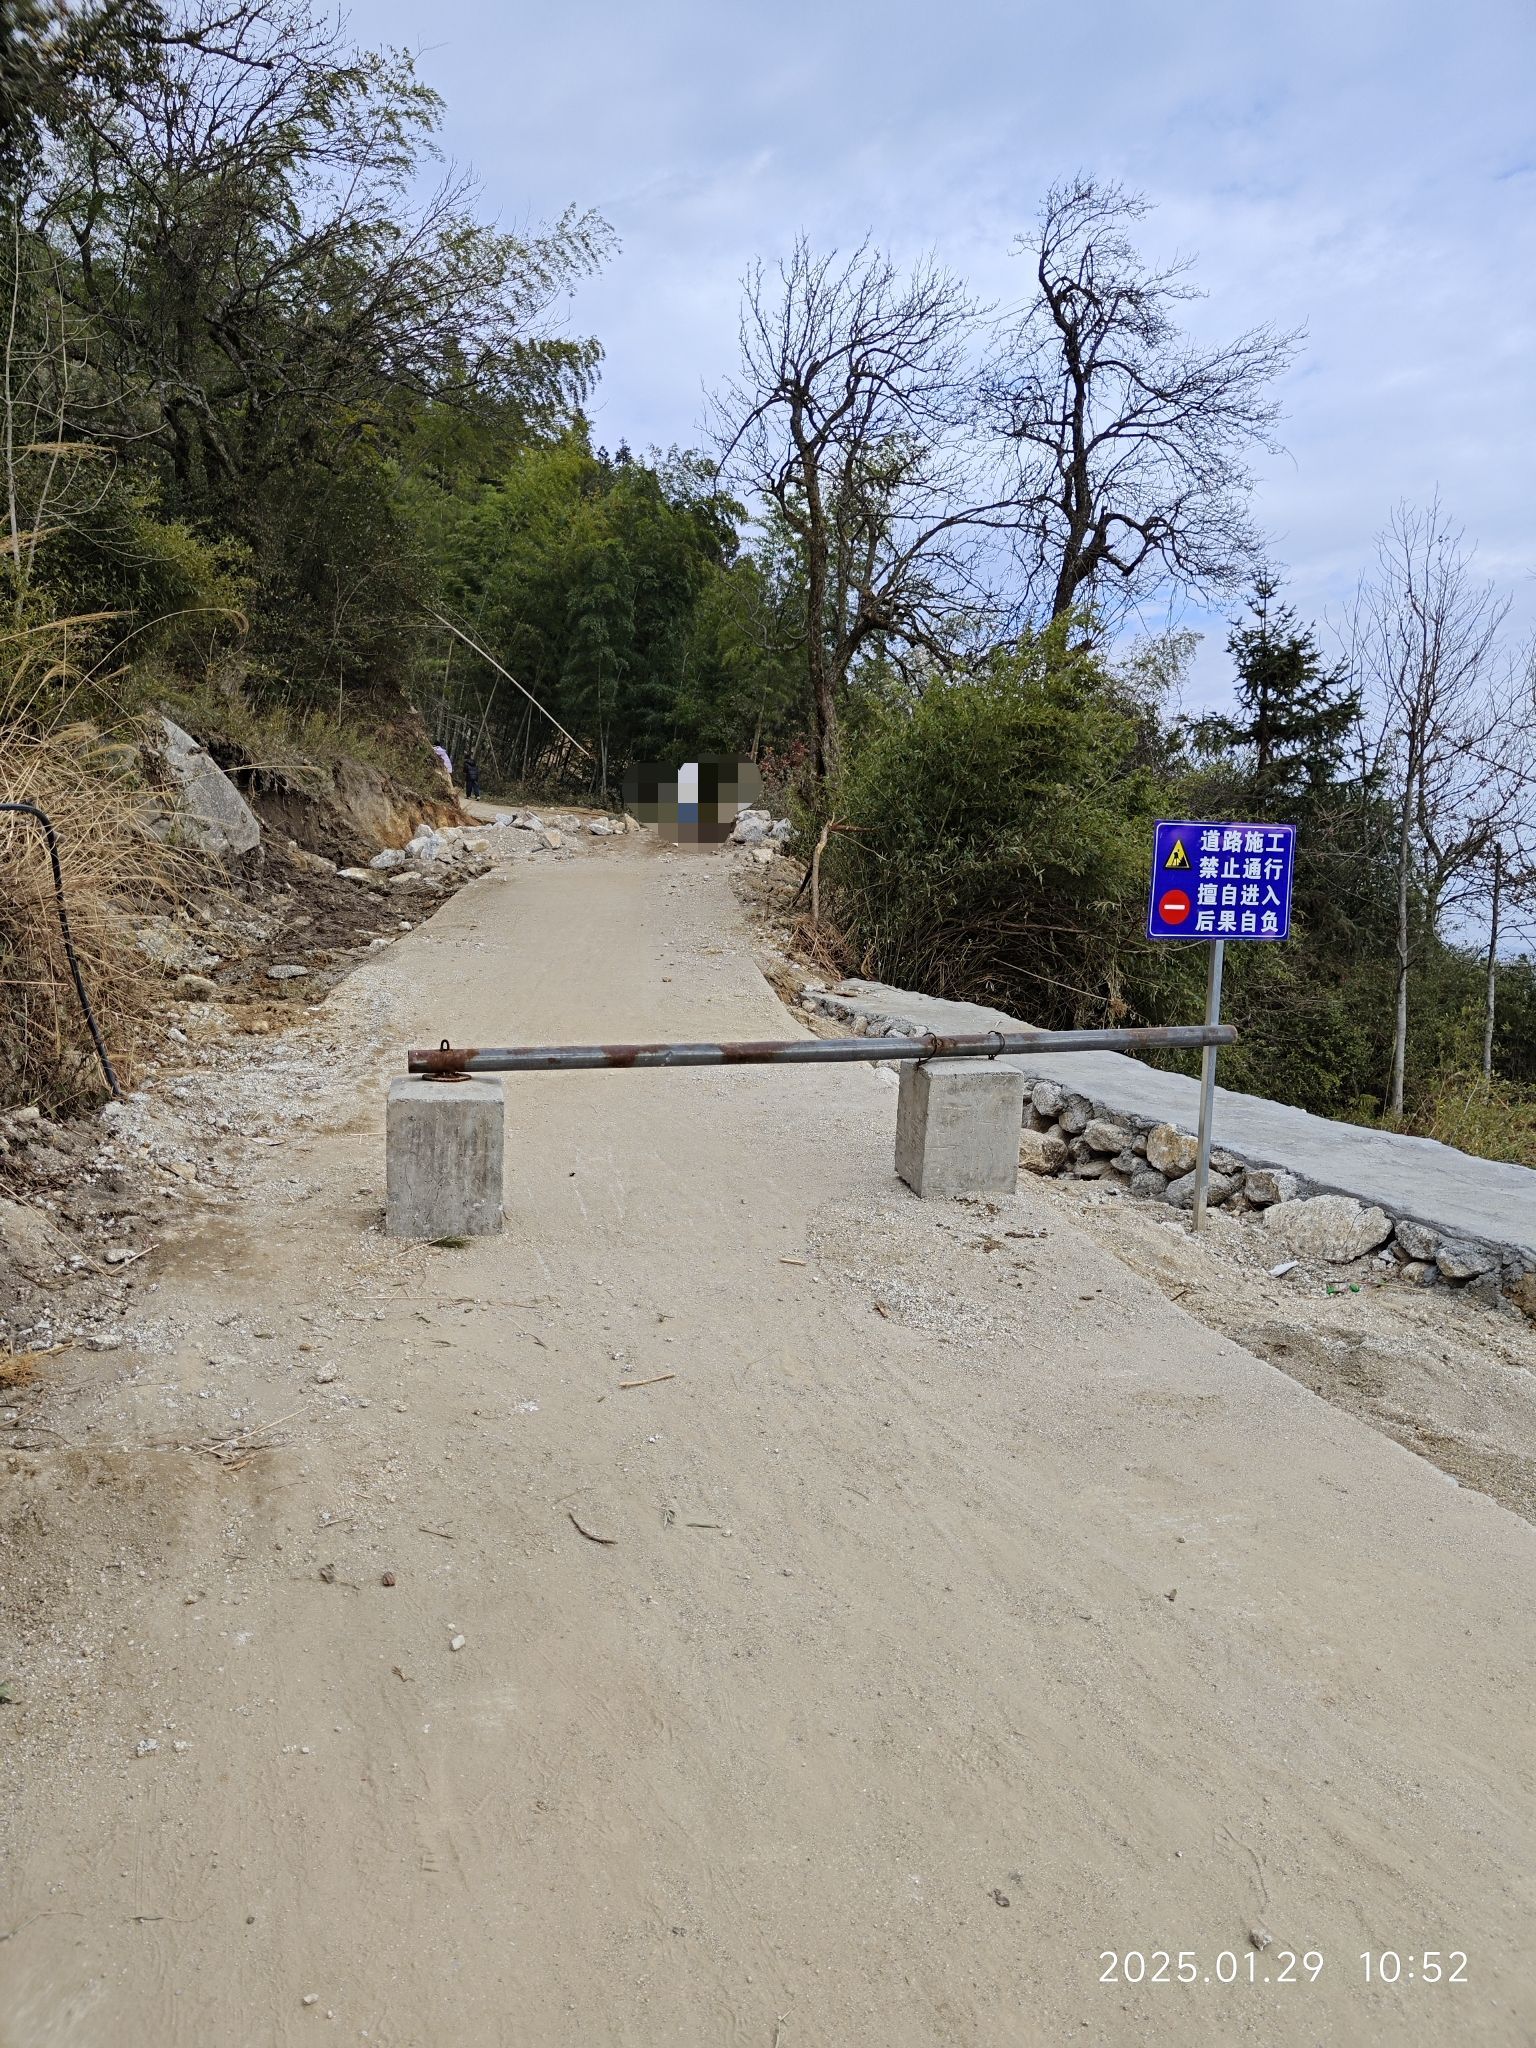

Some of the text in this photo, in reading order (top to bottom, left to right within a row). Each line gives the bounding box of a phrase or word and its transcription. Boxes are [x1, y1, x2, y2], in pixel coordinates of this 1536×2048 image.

[1200, 830, 1285, 853] 道路施工
[1199, 856, 1284, 880] 禁止通行
[1197, 883, 1281, 906] 擅自进入
[1195, 910, 1279, 933] 后果自负
